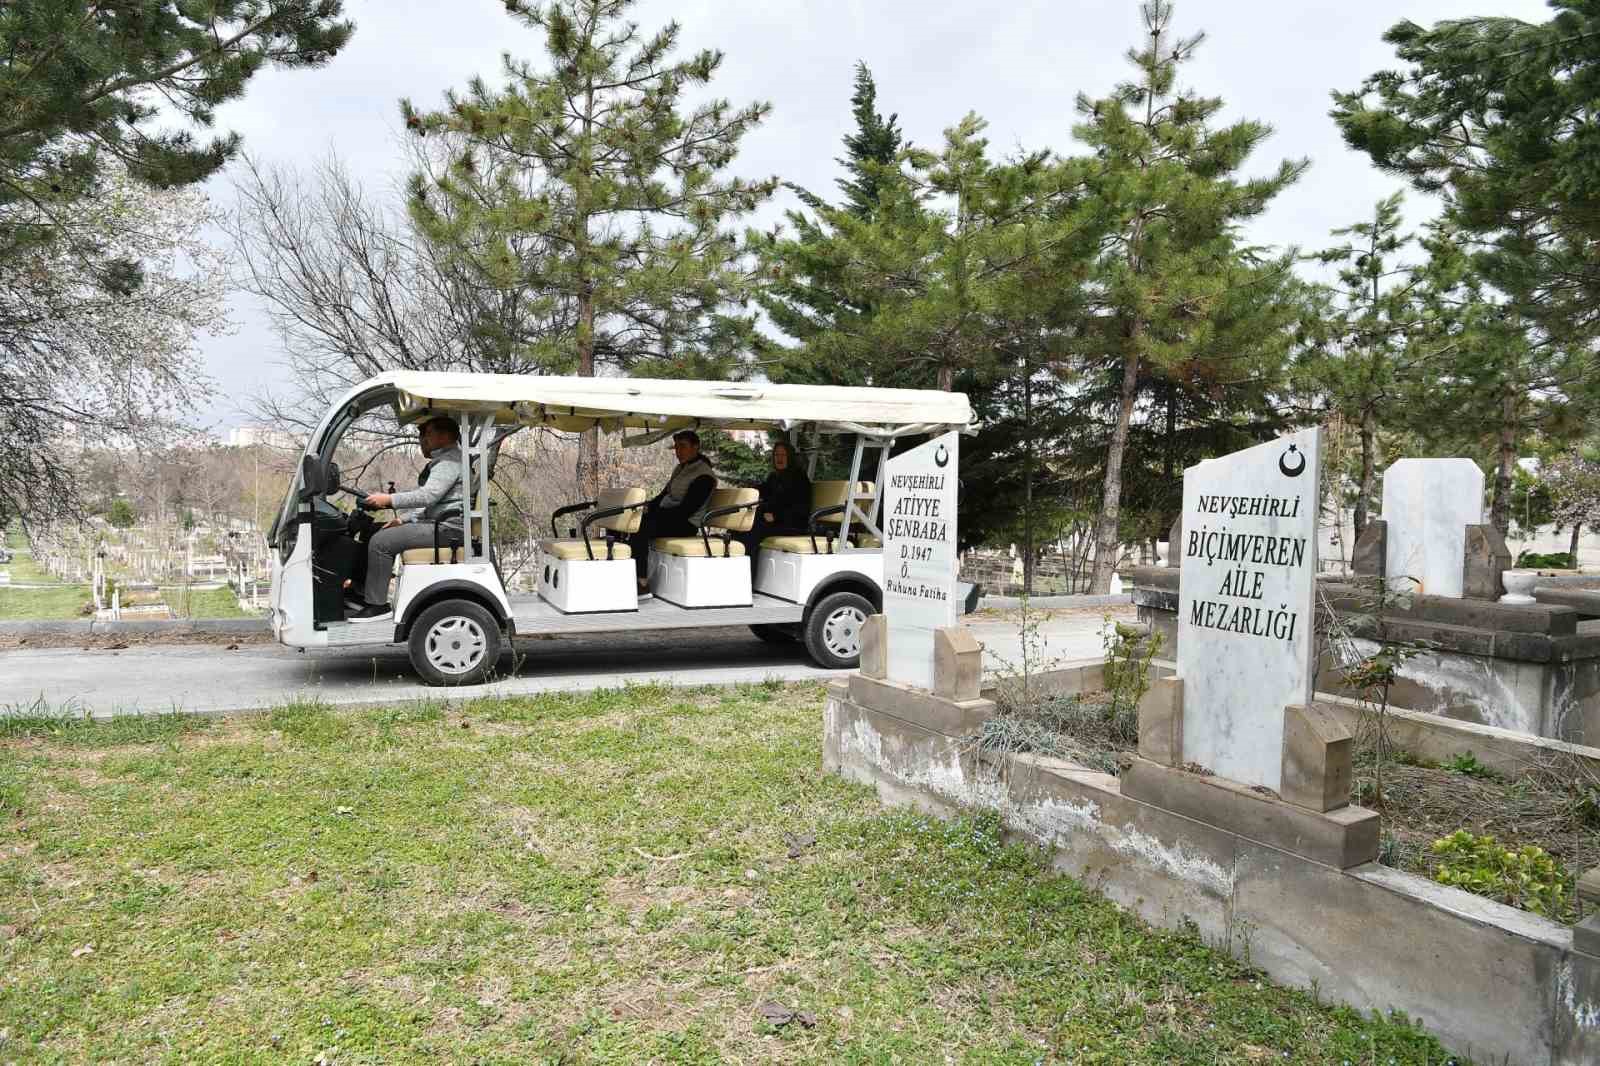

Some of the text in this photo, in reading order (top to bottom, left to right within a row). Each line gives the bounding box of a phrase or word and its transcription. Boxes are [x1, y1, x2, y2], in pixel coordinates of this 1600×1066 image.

[891, 473, 945, 492] NEVŞEHİRLİ
[893, 494, 941, 517] ATİYYE
[1197, 494, 1300, 519] NEVŞEHİRLİ
[888, 519, 946, 541] ŞENBABA
[901, 544, 932, 561] D.1947
[1187, 525, 1306, 568] BİÇİMVEREN
[887, 579, 947, 601] Ruhuna Fatiha
[1219, 563, 1265, 600] AİLE
[1190, 600, 1297, 641] MEZARLIĞI
